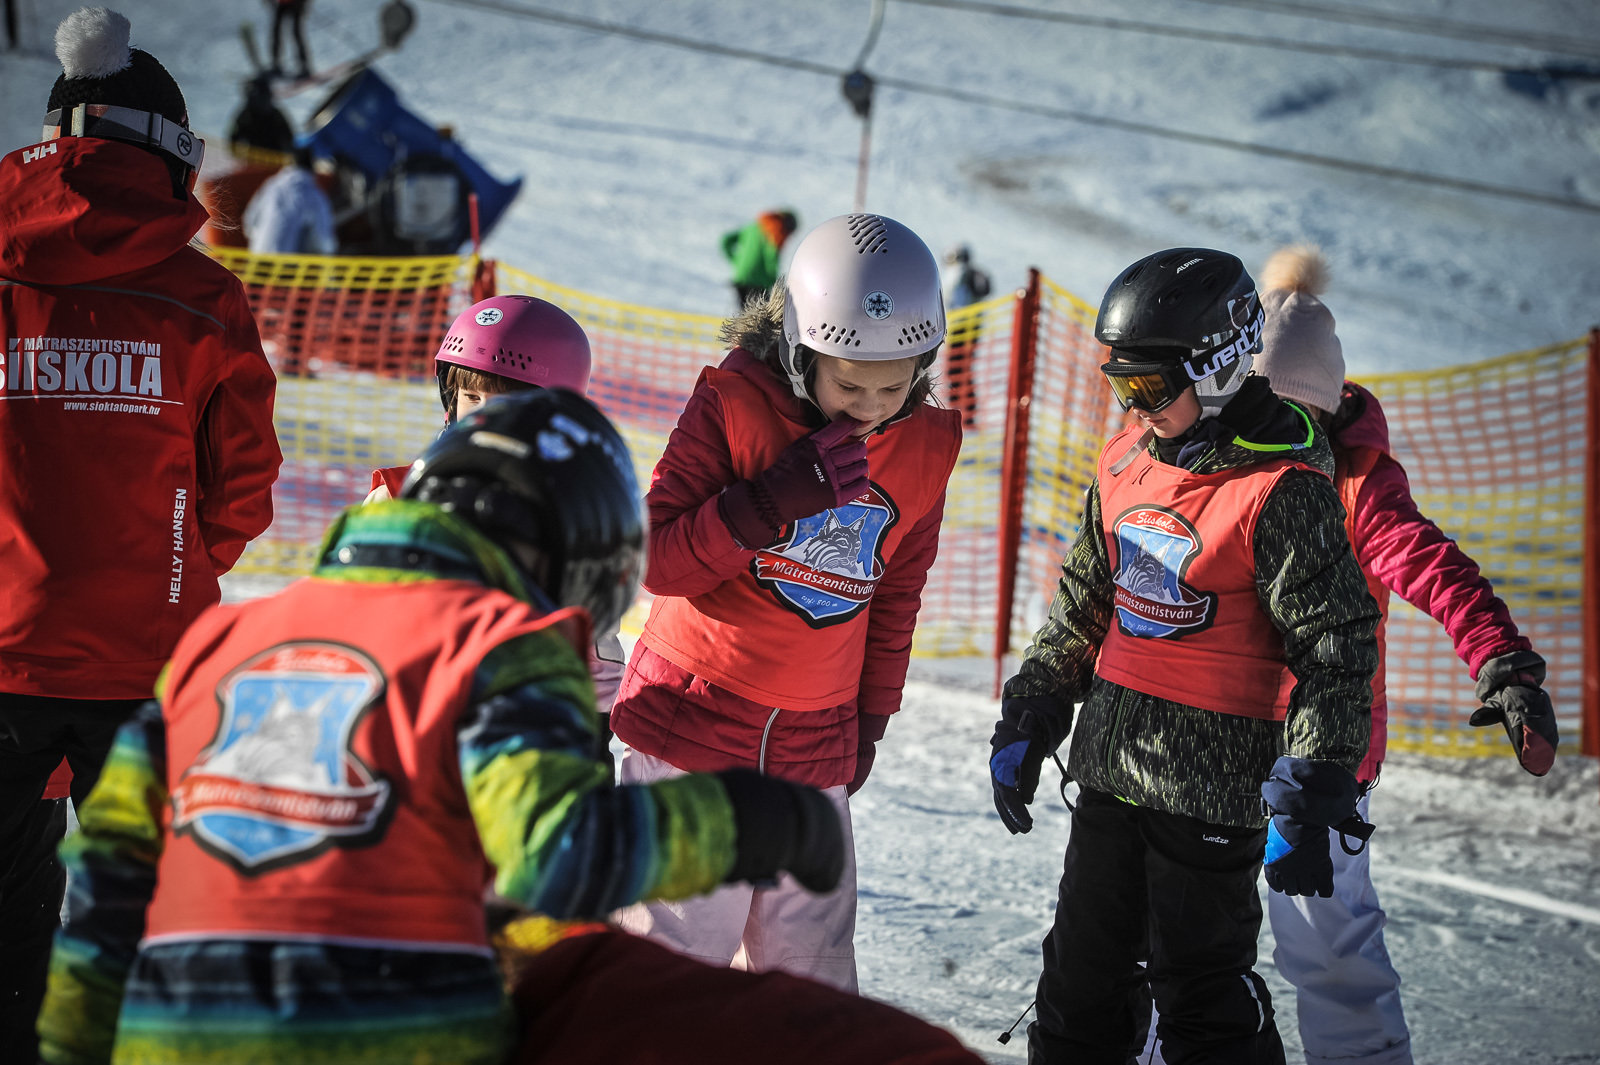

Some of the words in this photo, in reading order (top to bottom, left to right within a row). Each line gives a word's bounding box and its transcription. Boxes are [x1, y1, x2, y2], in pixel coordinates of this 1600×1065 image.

[22, 143, 58, 164] HH
[24, 335, 162, 357] MÁTRASZENTISTVÁNI
[173, 488, 187, 552] HANSEN
[168, 555, 184, 604] HELLY
[771, 561, 874, 595] Mátraszentistván
